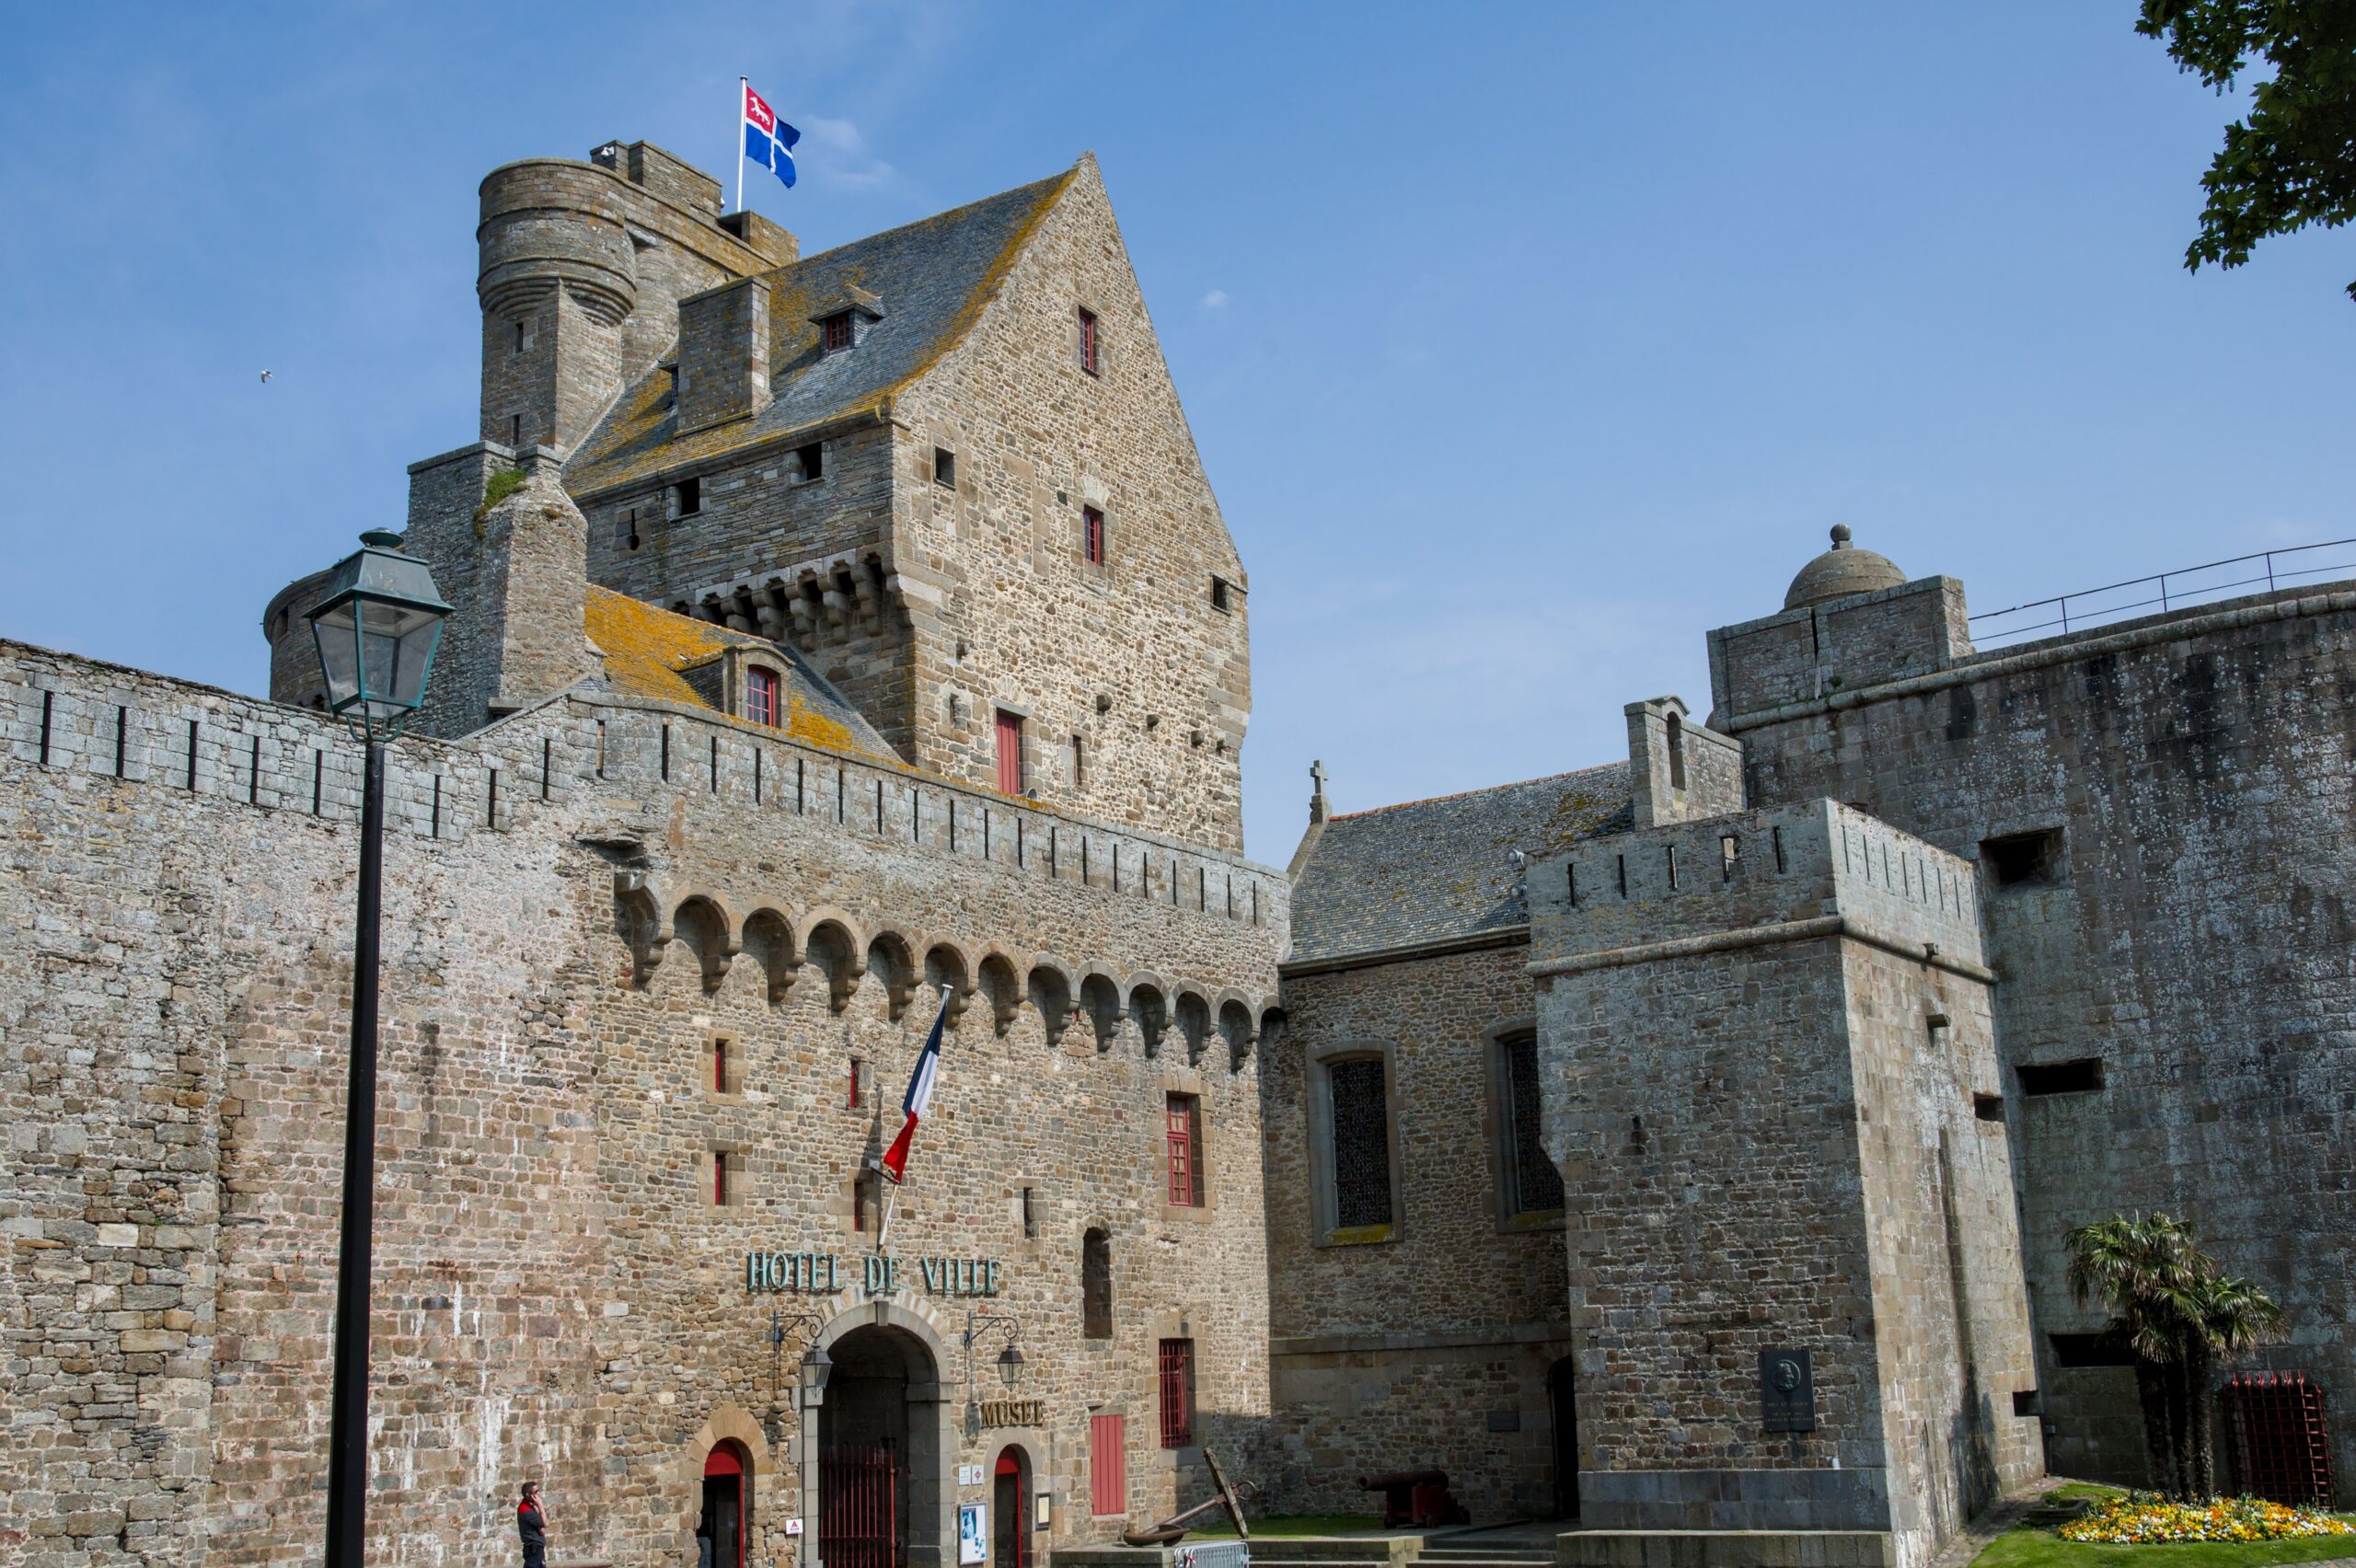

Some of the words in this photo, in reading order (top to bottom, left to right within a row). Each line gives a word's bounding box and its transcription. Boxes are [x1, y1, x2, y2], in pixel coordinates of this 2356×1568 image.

[747, 1251, 846, 1290] HOTEL
[864, 1255, 903, 1292] DE
[921, 1256, 1001, 1293] VILLE
[981, 1400, 1045, 1426] MUSEE
